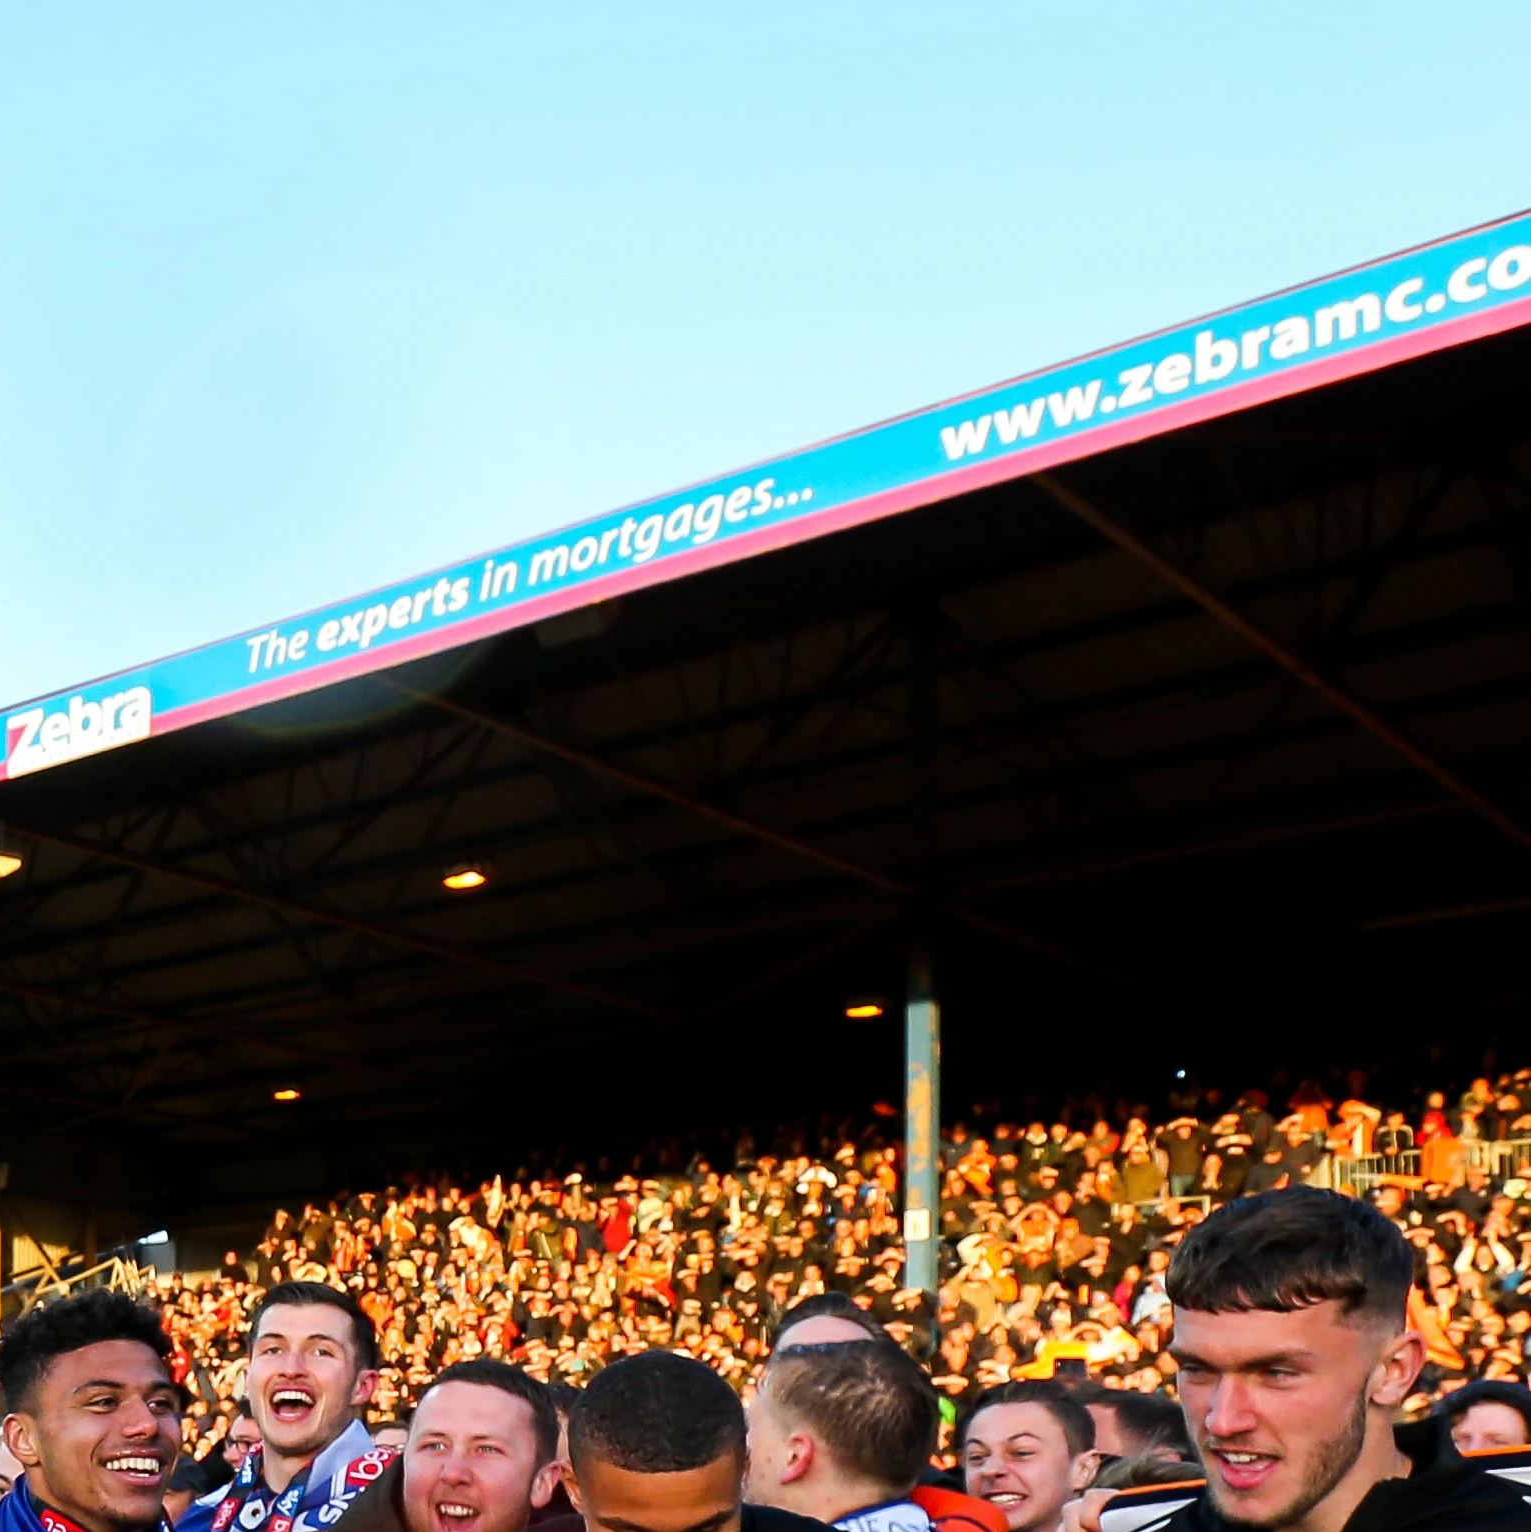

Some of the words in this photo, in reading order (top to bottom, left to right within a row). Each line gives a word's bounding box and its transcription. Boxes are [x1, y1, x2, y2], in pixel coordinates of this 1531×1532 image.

[245, 629, 308, 674] The
[316, 576, 469, 652] experts
[479, 558, 518, 601] in
[527, 475, 814, 588] mortgages...
[7, 685, 151, 768] Zebra
